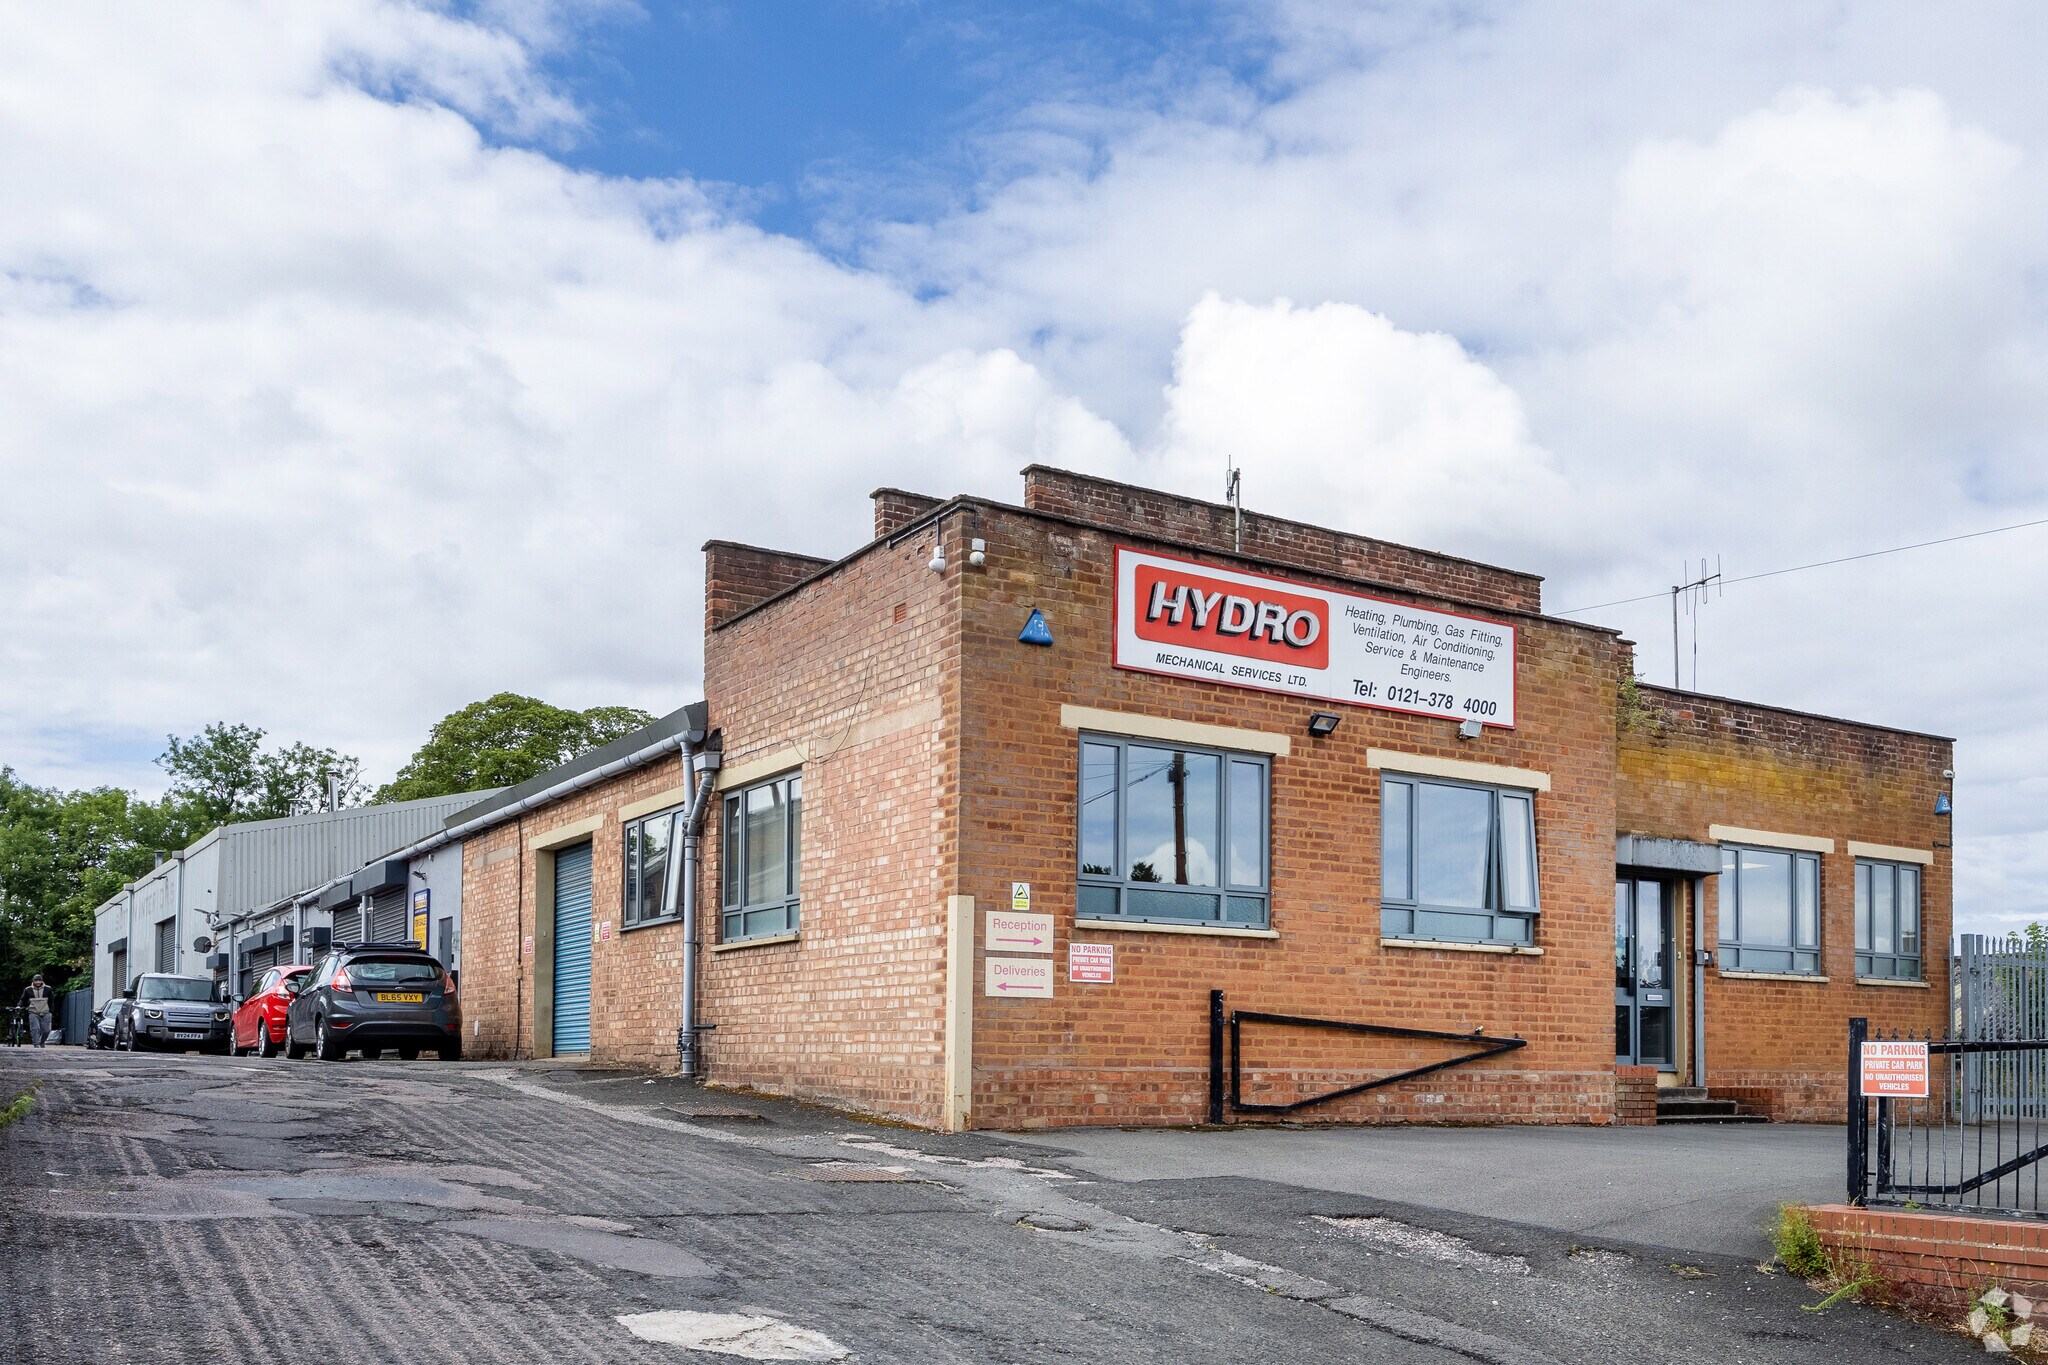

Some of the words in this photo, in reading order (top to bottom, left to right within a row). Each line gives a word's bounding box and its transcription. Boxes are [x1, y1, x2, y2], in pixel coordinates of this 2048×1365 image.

[1147, 581, 1320, 648] HYDRO
[1345, 605, 1386, 625] Heating,
[1392, 614, 1440, 636] Plumbing,
[1445, 624, 1465, 638] Gas
[1470, 629, 1503, 647] Fitting,
[1353, 623, 1406, 644] Ventilation,
[1412, 635, 1428, 647] Air
[1433, 638, 1496, 661] Conditioning,
[1365, 641, 1404, 659] Service
[1409, 650, 1417, 661] &
[1423, 652, 1484, 673] Maintenance
[1156, 653, 1225, 674] MECHANICAL
[1231, 666, 1282, 682] SERVICES
[1288, 675, 1307, 687] LTD.
[1400, 664, 1452, 683] Engineers.
[1353, 679, 1378, 698] Tel:
[1463, 698, 1497, 716] 4000
[993, 918, 1047, 932] Reception
[1072, 945, 1081, 953] NO
[1083, 946, 1111, 954] PARKING
[994, 965, 1046, 977] Deliveries
[1863, 1044, 1877, 1055] NO
[1881, 1044, 1926, 1056] PARKING
[1864, 1060, 1890, 1070] PRIVATE
[1891, 1060, 1905, 1070] CAR
[1906, 1060, 1924, 1070] PARK
[1875, 1073, 1924, 1082] UNAUTHORISED
[1879, 1082, 1910, 1091] VEHICLES
